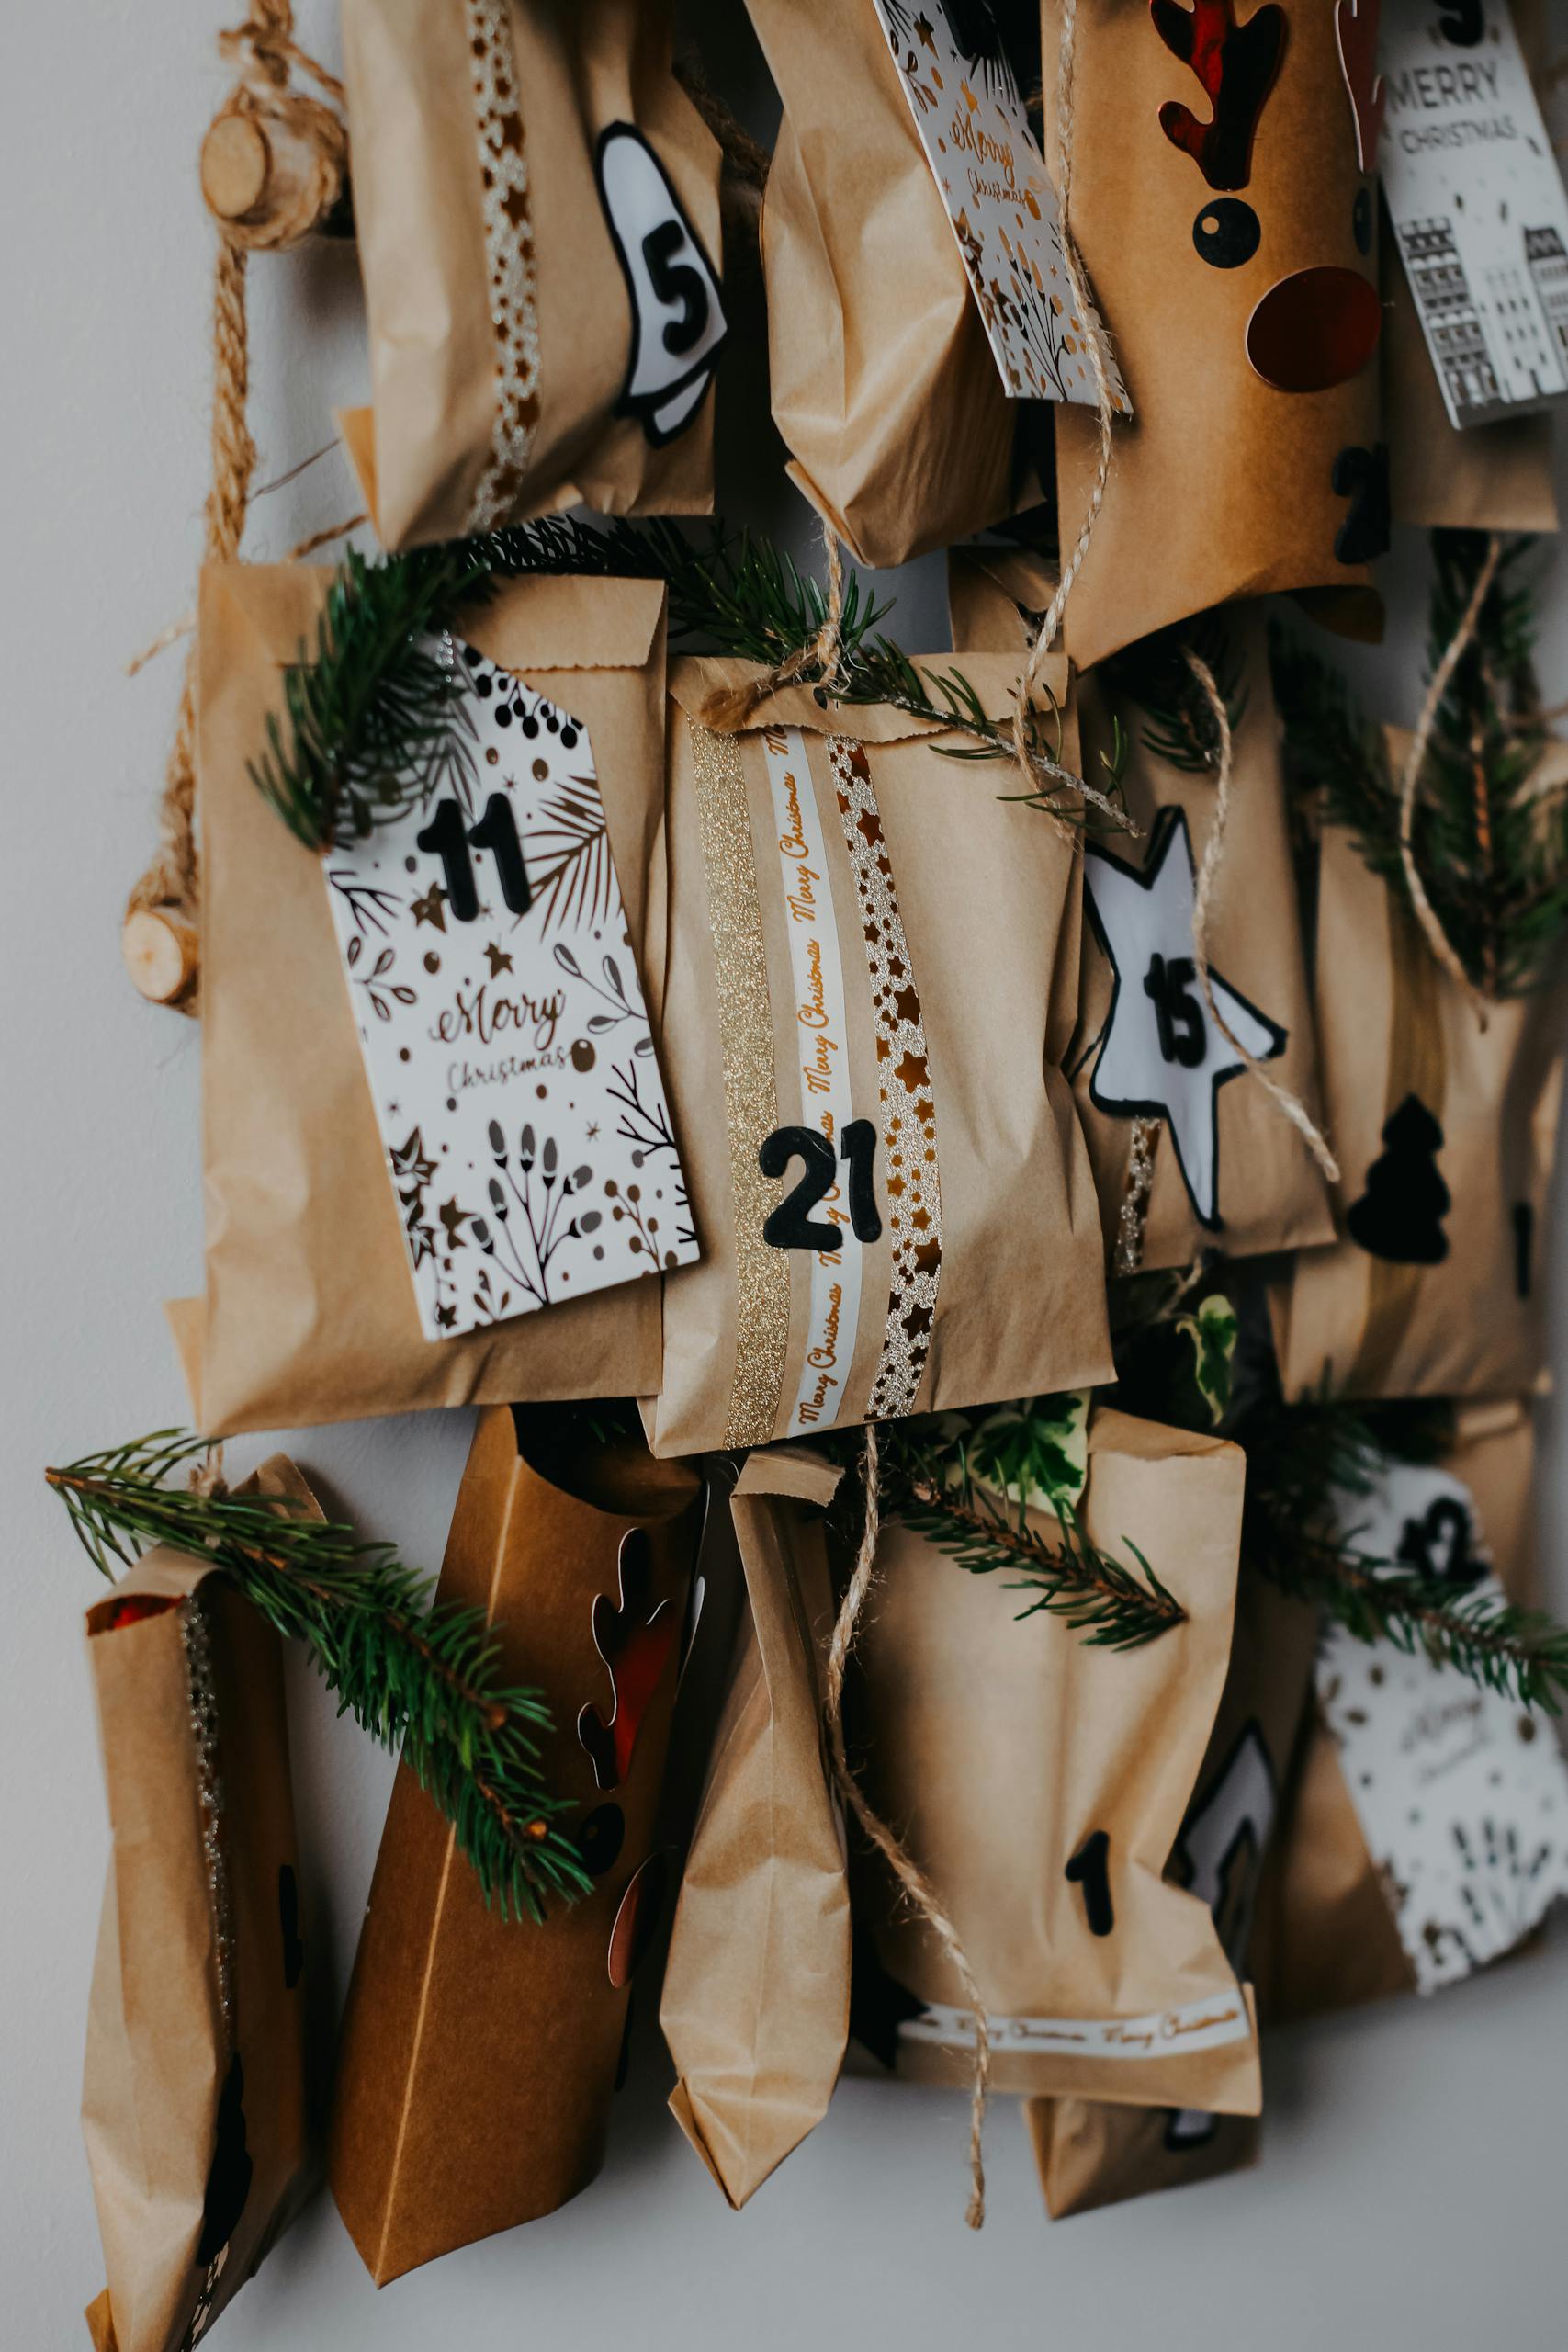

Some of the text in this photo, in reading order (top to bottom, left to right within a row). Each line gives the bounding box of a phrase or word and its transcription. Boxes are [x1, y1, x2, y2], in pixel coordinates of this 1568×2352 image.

[1382, 58, 1500, 115] MERRY
[642, 220, 709, 356] 5
[417, 793, 532, 922] 11
[779, 771, 809, 859] Christmas
[787, 864, 820, 922] Merry
[428, 985, 566, 1051] Merry
[797, 938, 829, 1029] Christmas
[1143, 952, 1207, 1069] 15
[448, 1046, 568, 1093] Christmas
[803, 1035, 839, 1094] Merry
[759, 1119, 882, 1251] 21
[807, 1283, 842, 1369] Christmas
[798, 1374, 838, 1425] Merry
[1065, 1829, 1114, 1937] 1
